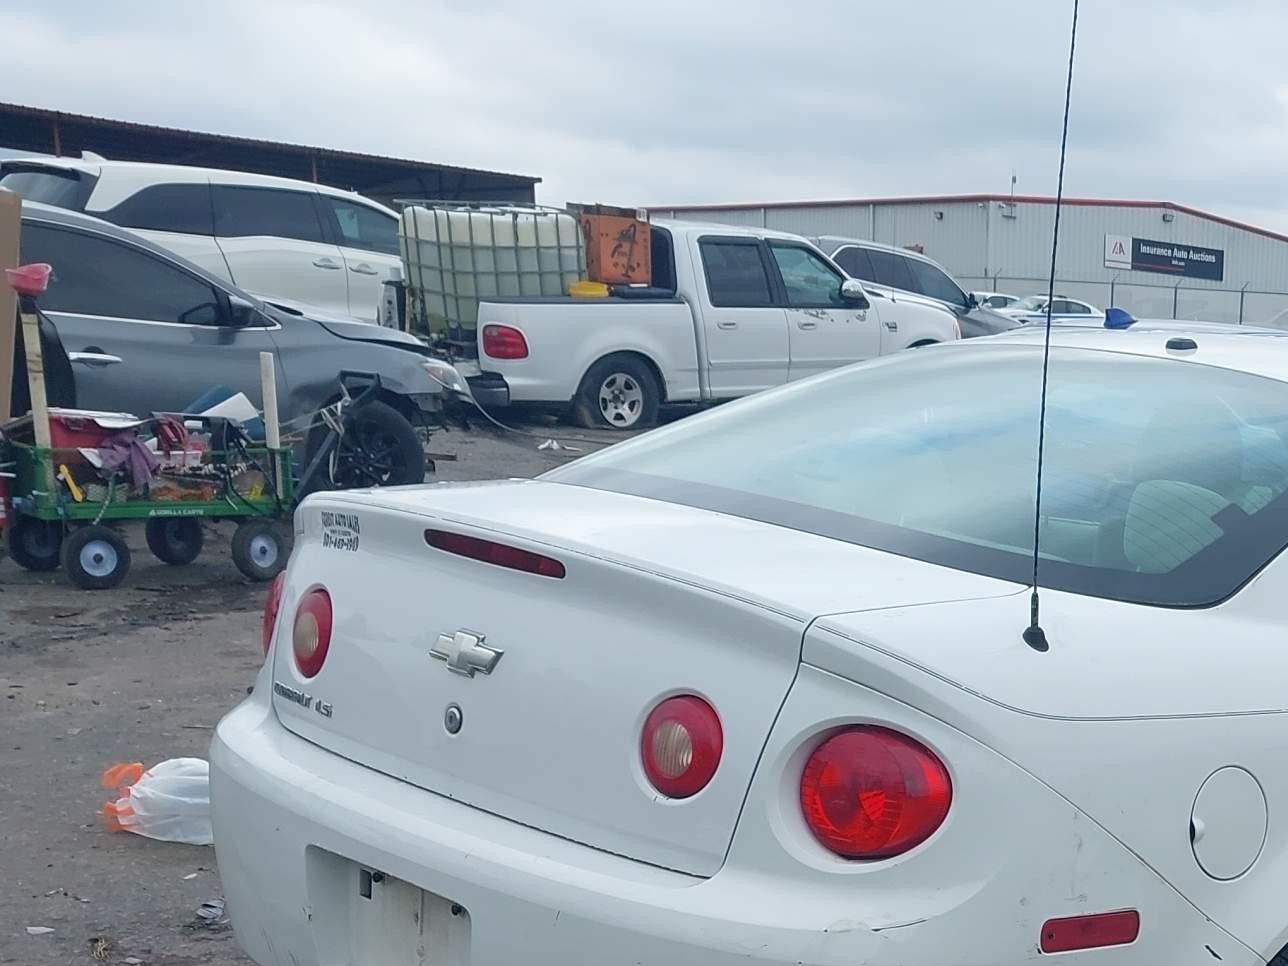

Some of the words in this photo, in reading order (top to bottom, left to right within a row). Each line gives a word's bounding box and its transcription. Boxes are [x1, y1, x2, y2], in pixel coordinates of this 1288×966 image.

[1140, 242, 1172, 257] Insurance
[1172, 247, 1188, 259] Auto
[1188, 249, 1216, 263] Auctions
